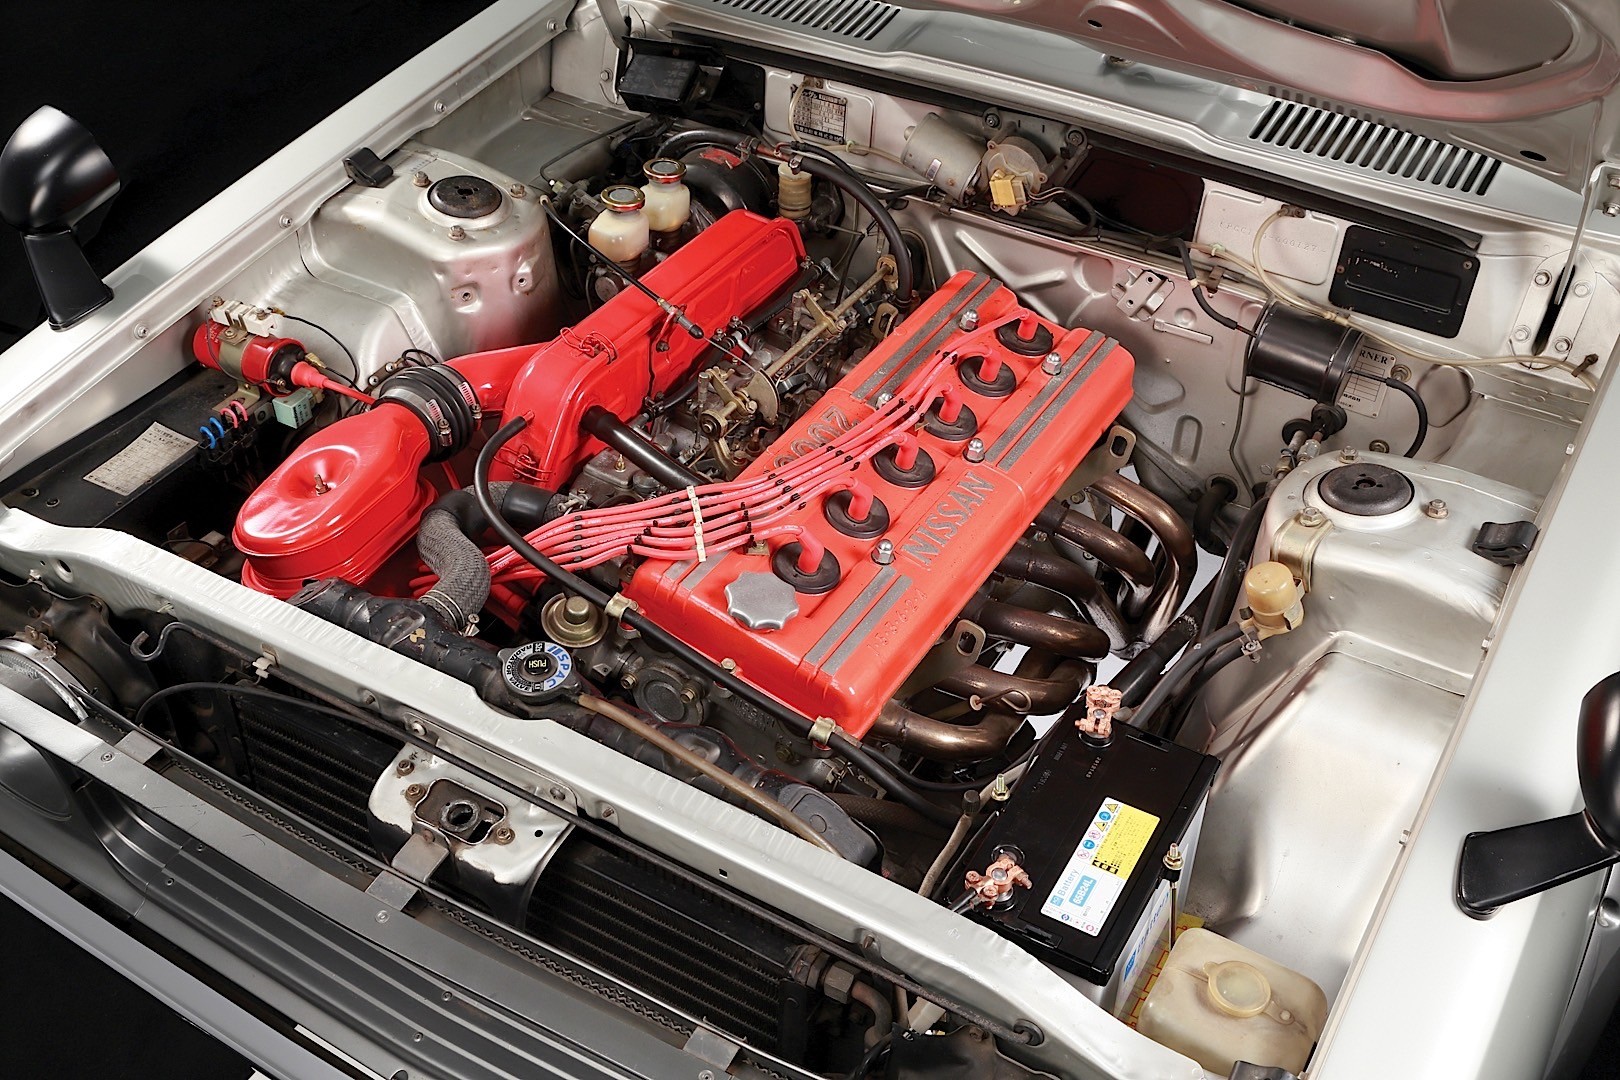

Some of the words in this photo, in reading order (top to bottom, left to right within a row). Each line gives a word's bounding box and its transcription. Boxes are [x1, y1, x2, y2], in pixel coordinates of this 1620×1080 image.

[1360, 348, 1388, 365] RNER
[901, 472, 996, 567] NISSAN
[506, 644, 533, 675] RADIATOR
[528, 659, 547, 669] PUSH
[1057, 868, 1080, 896] Battery
[1073, 878, 1094, 904] 65B24L
